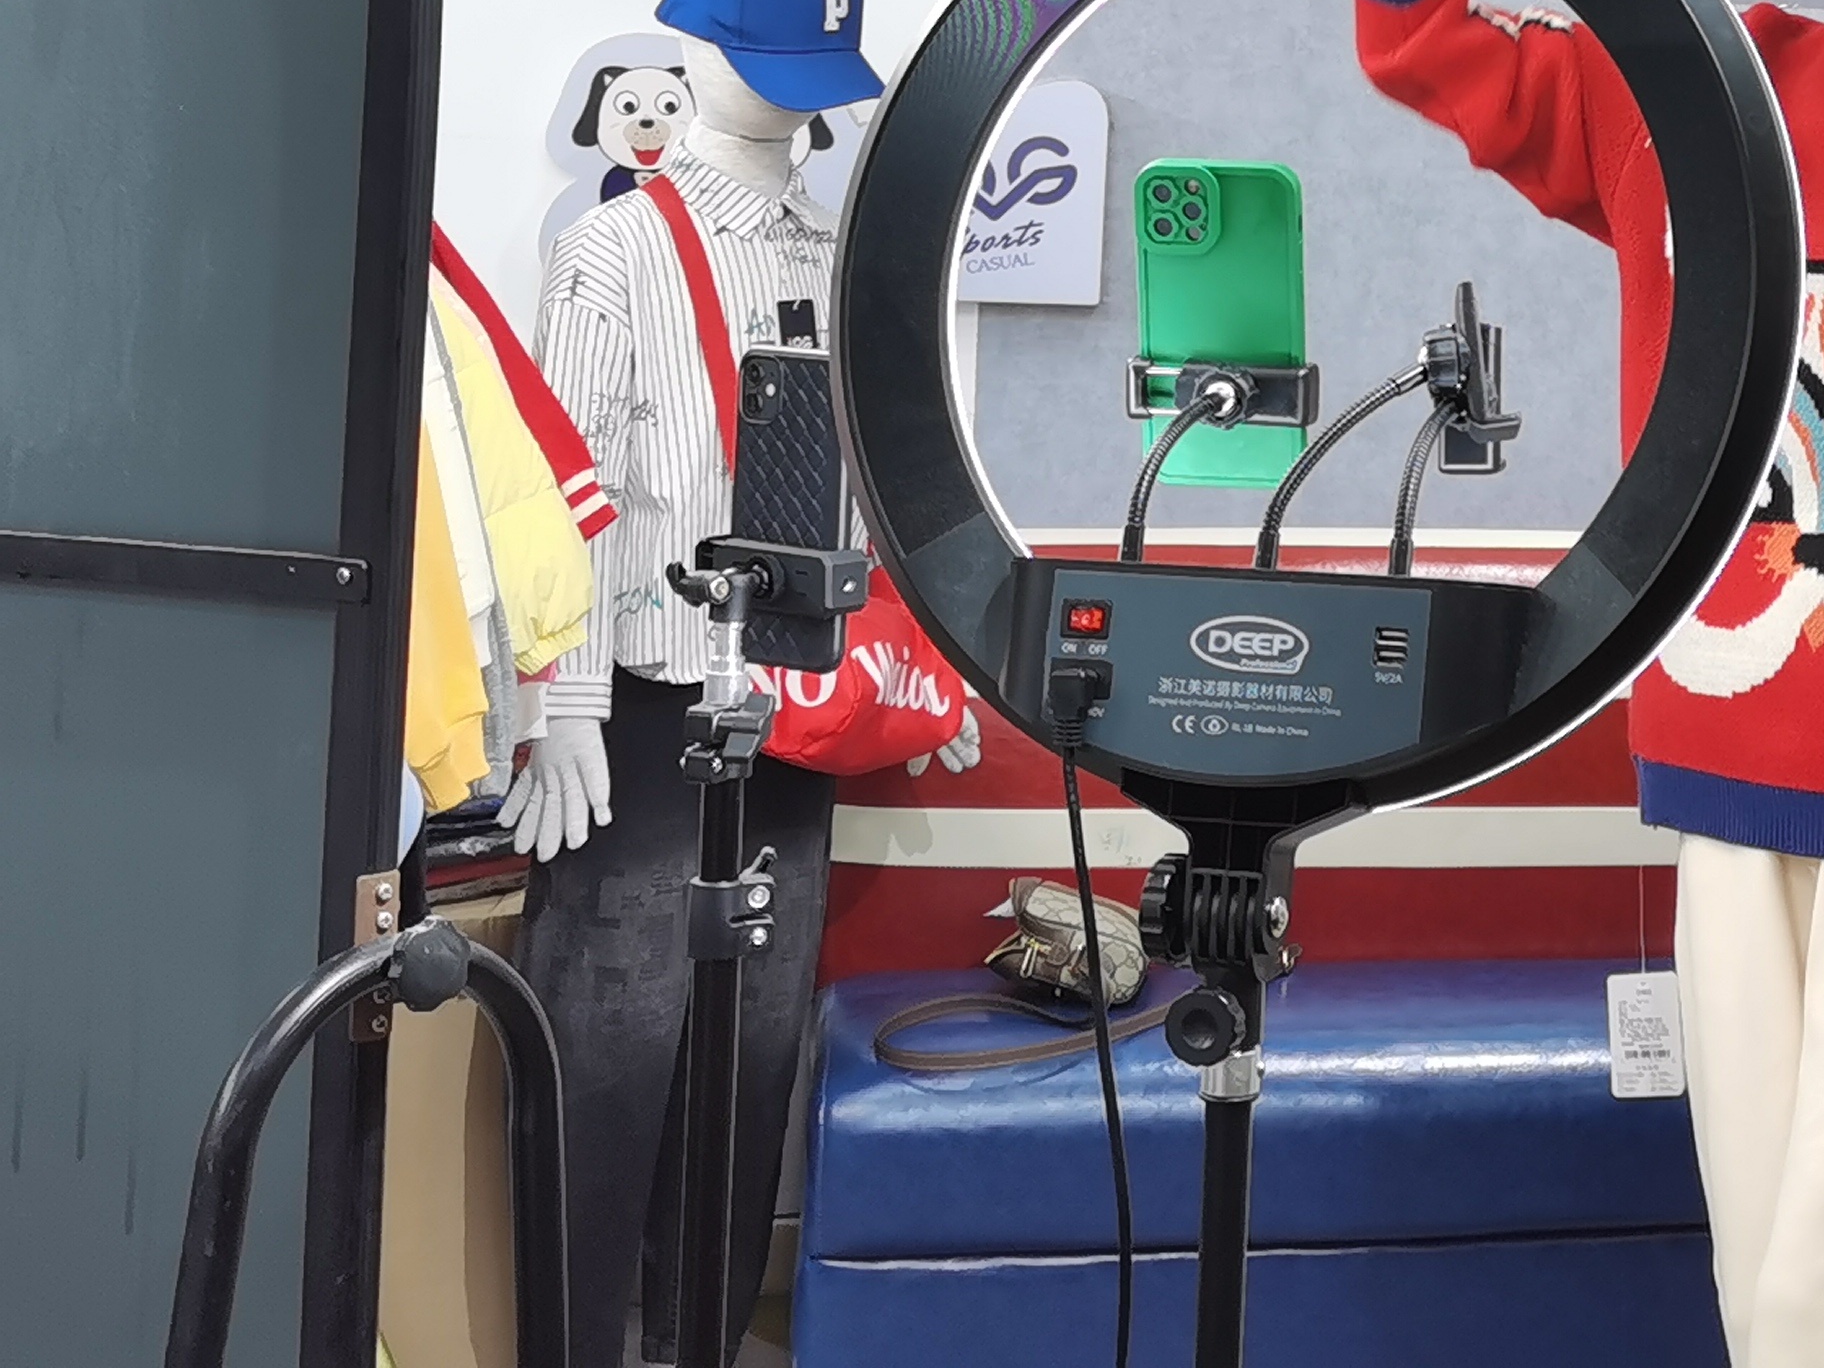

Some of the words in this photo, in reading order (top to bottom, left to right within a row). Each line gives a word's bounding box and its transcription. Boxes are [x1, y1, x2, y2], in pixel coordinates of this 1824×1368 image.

[960, 219, 1045, 261] ports
[966, 252, 1035, 274] CASUAL
[1061, 642, 1078, 654] ON
[1088, 643, 1108, 655] OFF
[1208, 629, 1295, 656] DEEP
